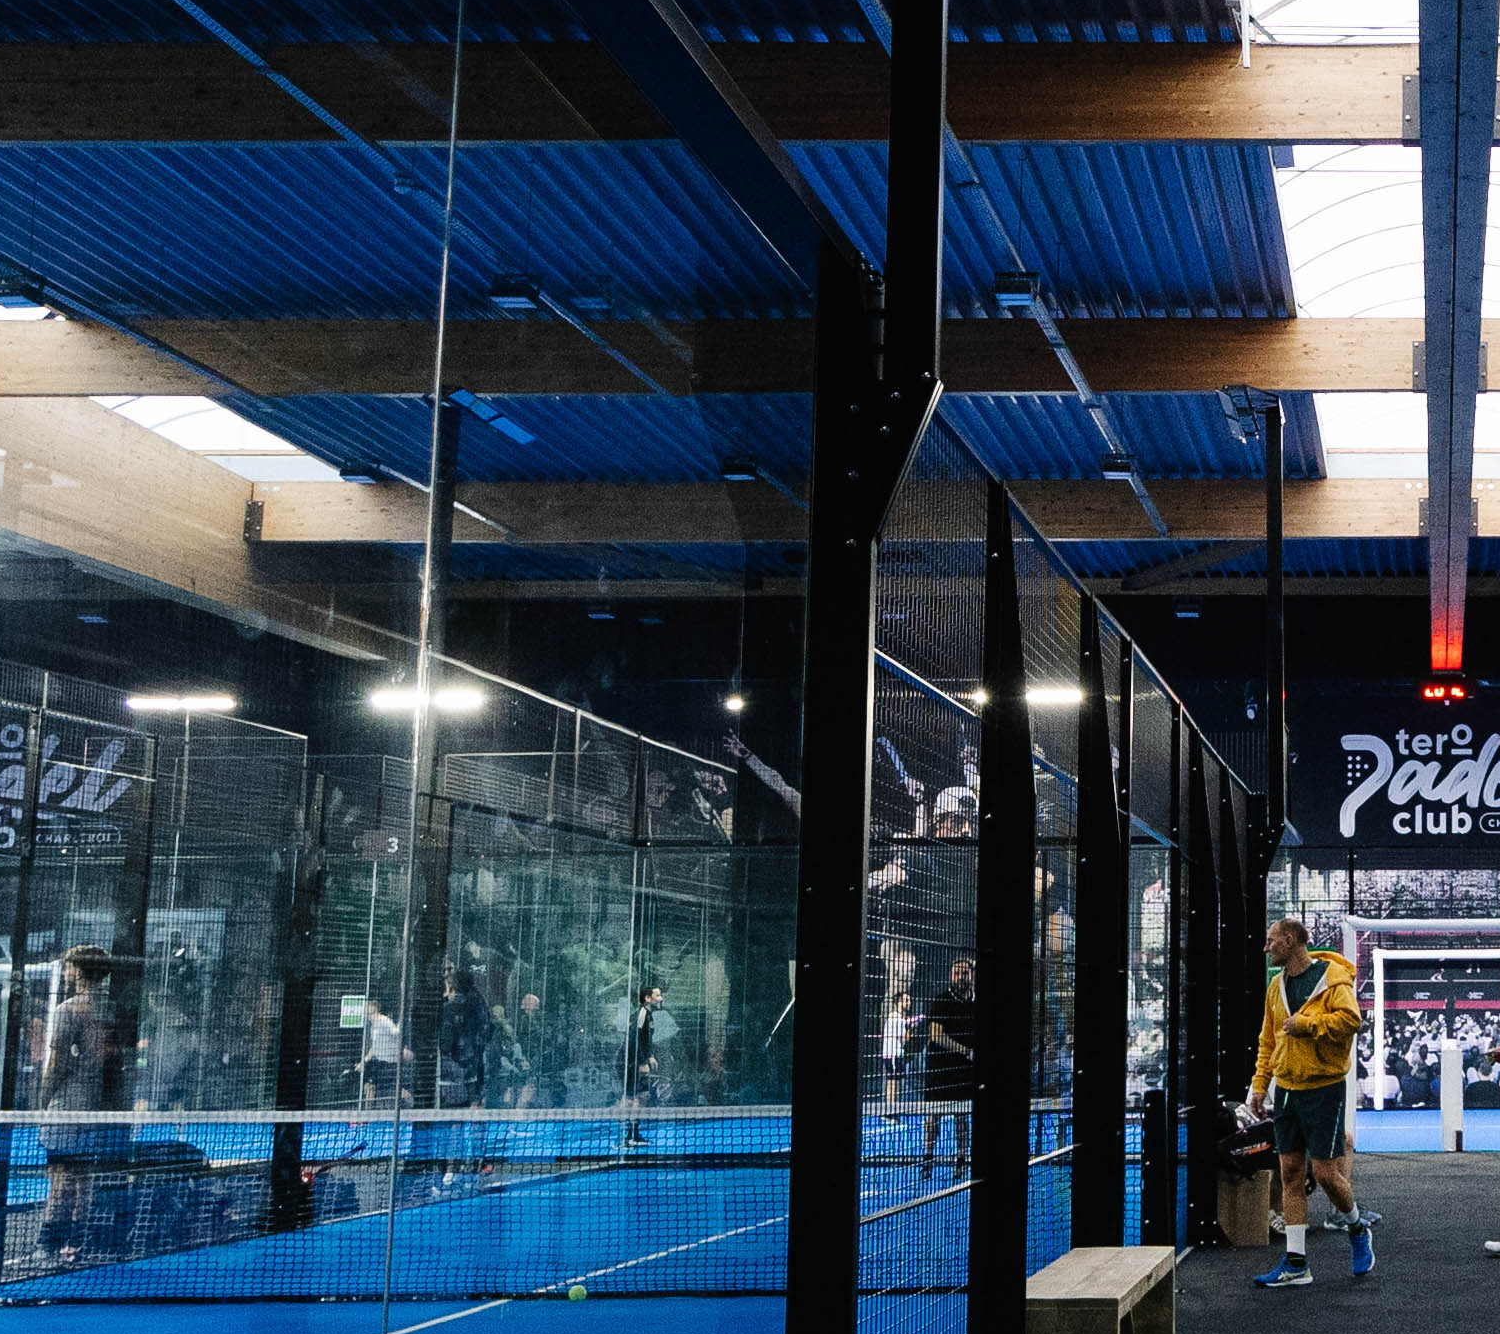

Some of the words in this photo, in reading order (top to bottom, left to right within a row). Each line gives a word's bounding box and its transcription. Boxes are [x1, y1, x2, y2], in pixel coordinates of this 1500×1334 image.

[1395, 723, 1473, 756] tero
[1392, 803, 1473, 835] club
[387, 836, 399, 854] 3
